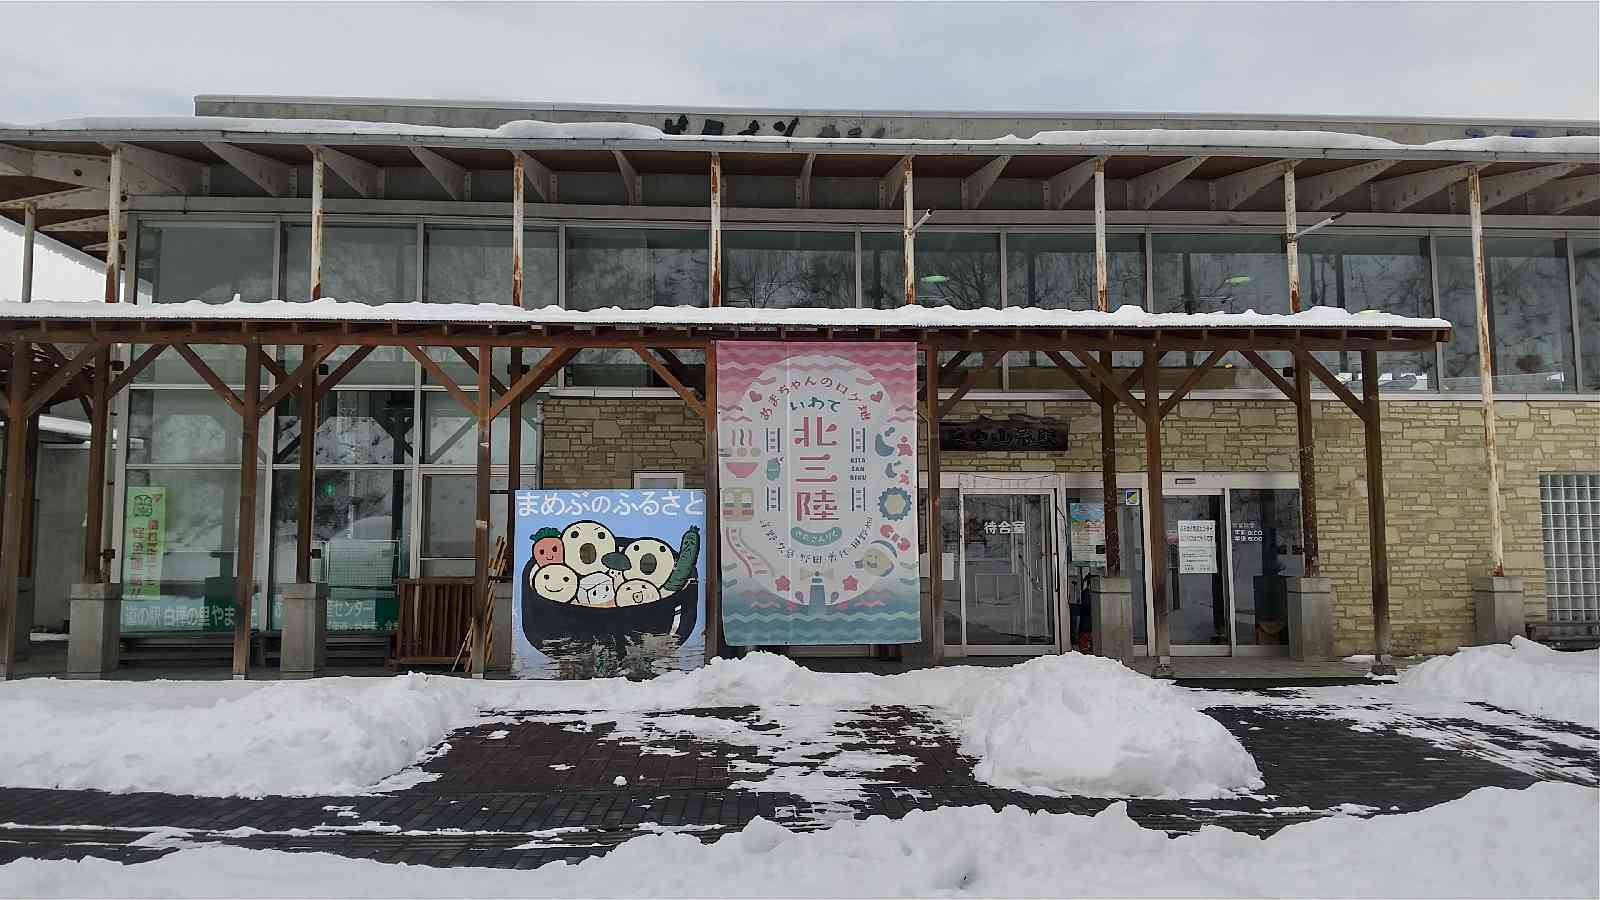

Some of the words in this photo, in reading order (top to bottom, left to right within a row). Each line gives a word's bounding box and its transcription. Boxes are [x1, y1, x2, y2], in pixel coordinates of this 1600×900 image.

[760, 376, 872, 420] あまちゃんのロケ地
[790, 397, 840, 413] いわて
[793, 416, 840, 521] 北三陸
[517, 491, 704, 516] まめぶのふるさと
[984, 520, 1026, 535] 待合室
